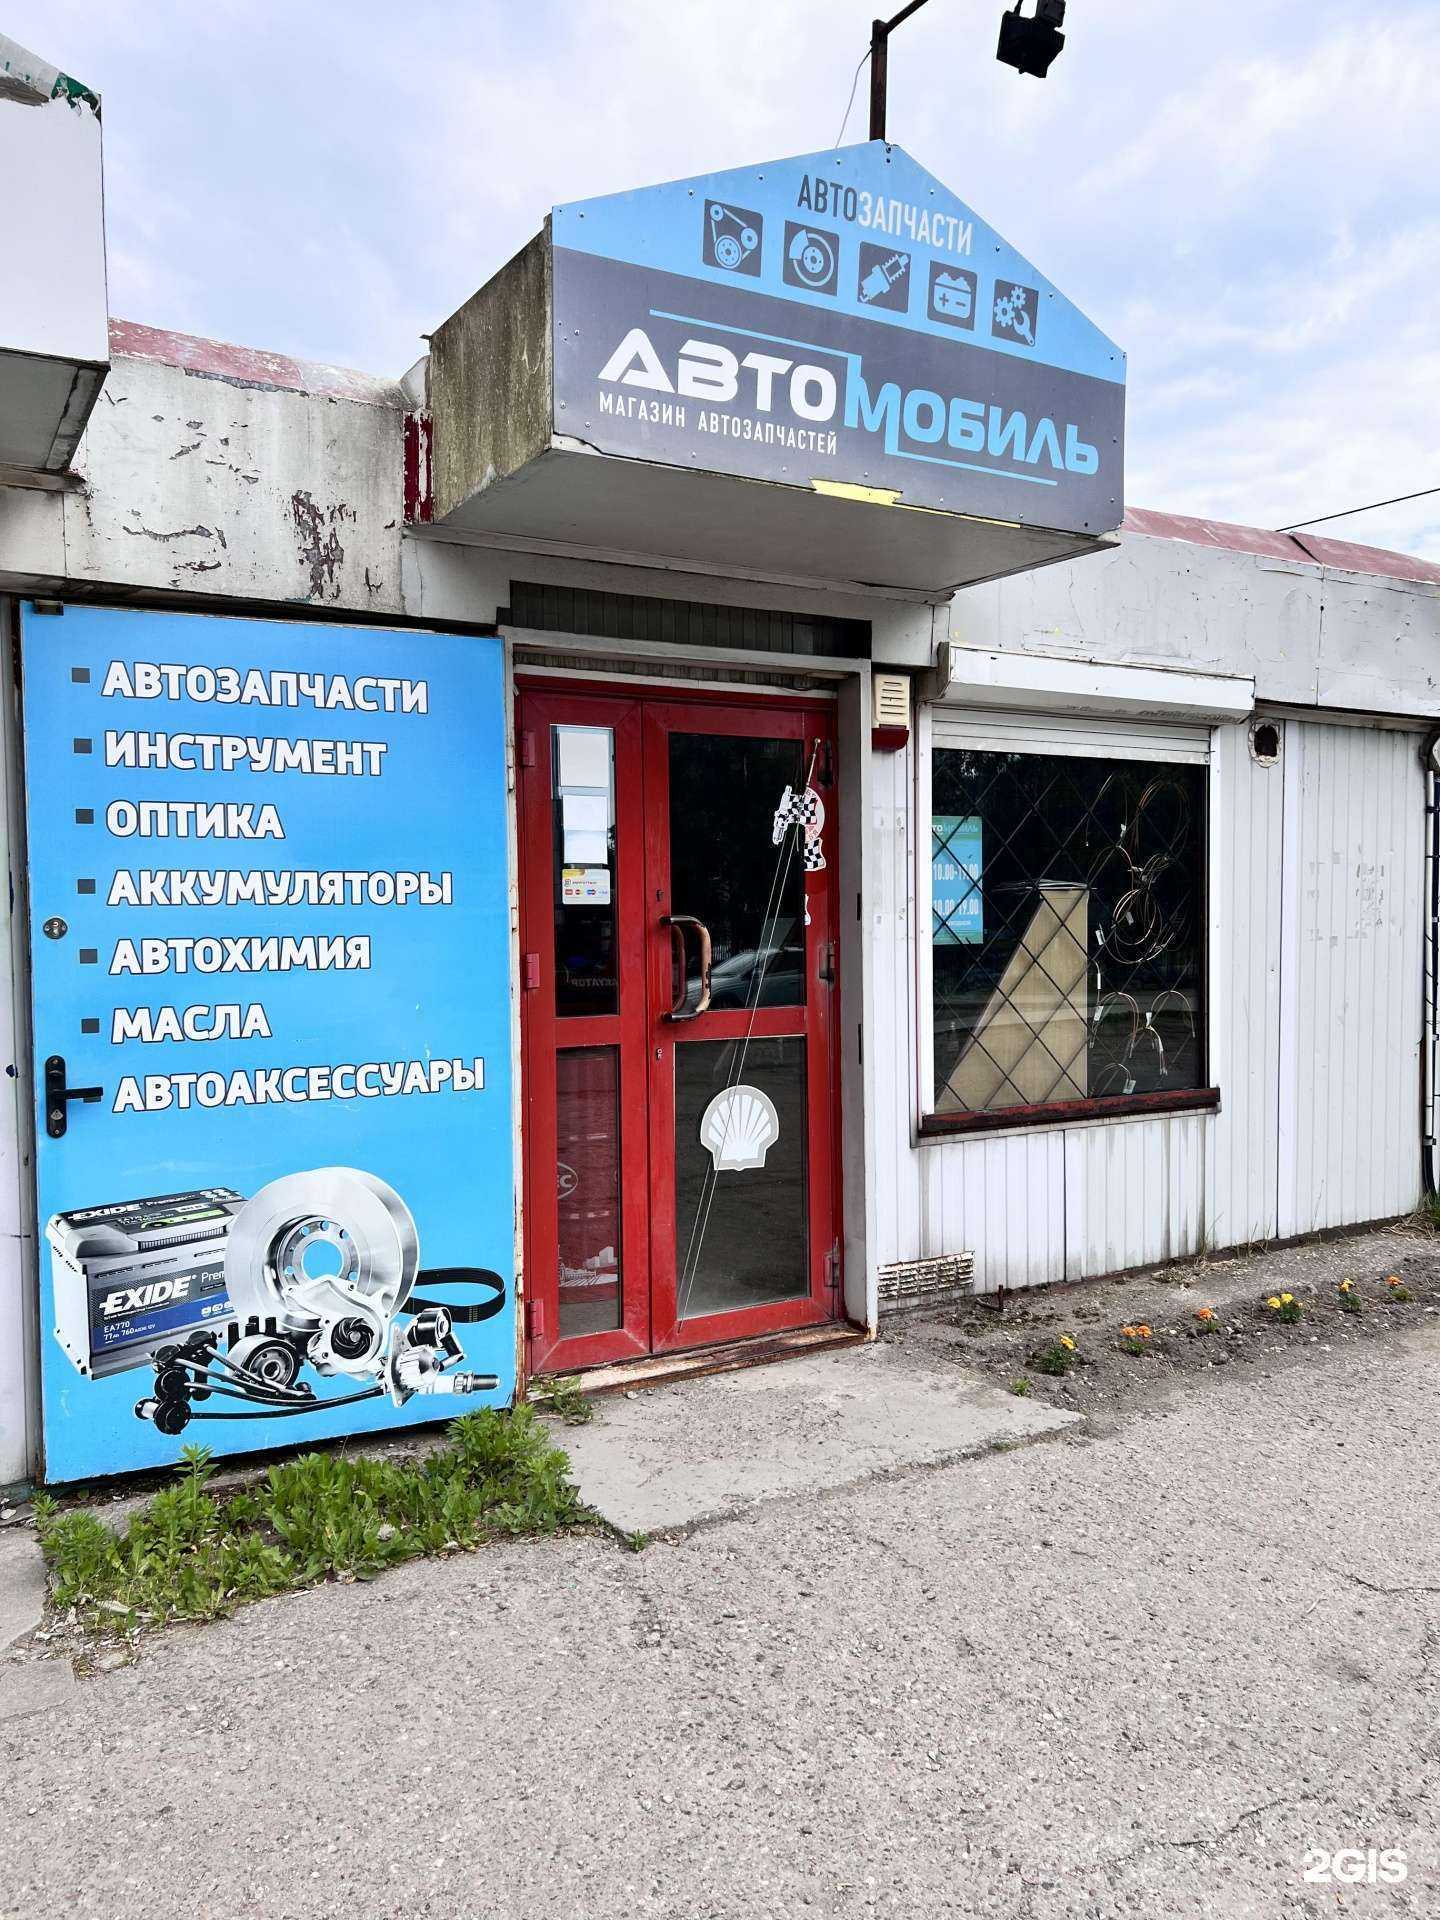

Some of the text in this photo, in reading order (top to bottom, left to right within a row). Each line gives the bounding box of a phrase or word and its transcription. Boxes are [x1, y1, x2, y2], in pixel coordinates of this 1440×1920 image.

[797, 174, 973, 256] АВТОЗАПЧАСТИ
[599, 391, 838, 456] МАГАЗИН АВТОЗАПЧАСТЕЙ
[101, 661, 429, 714] АВТОЗАПЧАСТИ
[104, 731, 388, 776] ИНСТРУМЕНТ
[106, 800, 285, 839] ОПТИКА
[107, 870, 453, 905] АККУМУЛЯТОРЫ
[108, 936, 371, 975] АВТОХИМИЯ
[110, 1003, 272, 1044] МАСЛА
[112, 1057, 485, 1113] АВТОАКСЕССУАРЫ
[68, 1203, 141, 1221] EXIDE
[99, 1275, 192, 1316] EXIDE
[103, 1320, 131, 1334] EA770
